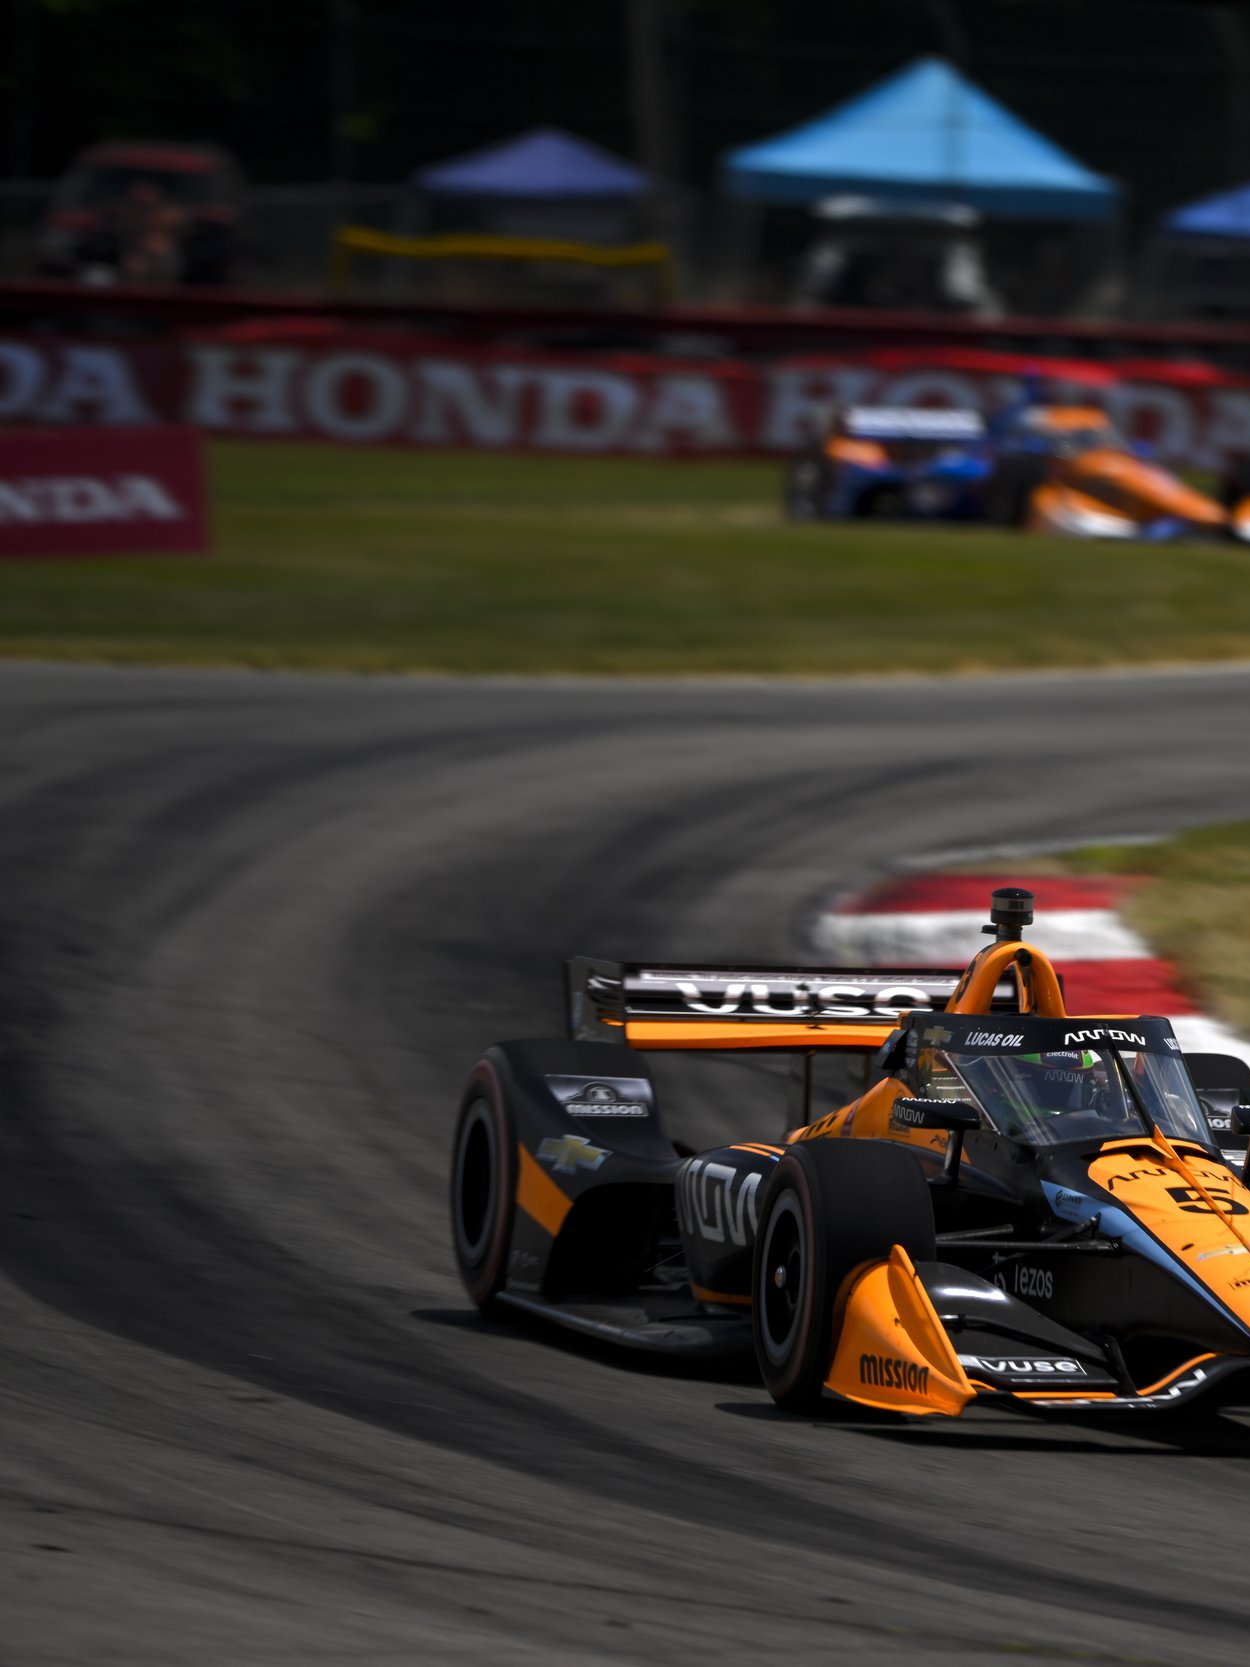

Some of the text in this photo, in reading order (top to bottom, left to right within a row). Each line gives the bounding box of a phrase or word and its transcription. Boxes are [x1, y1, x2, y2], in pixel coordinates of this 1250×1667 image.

[184, 342, 738, 451] HONDA
[964, 1031, 1025, 1048] LUCAS OIL
[1064, 1029, 1146, 1047] ARROW
[1165, 1187, 1249, 1215] 5
